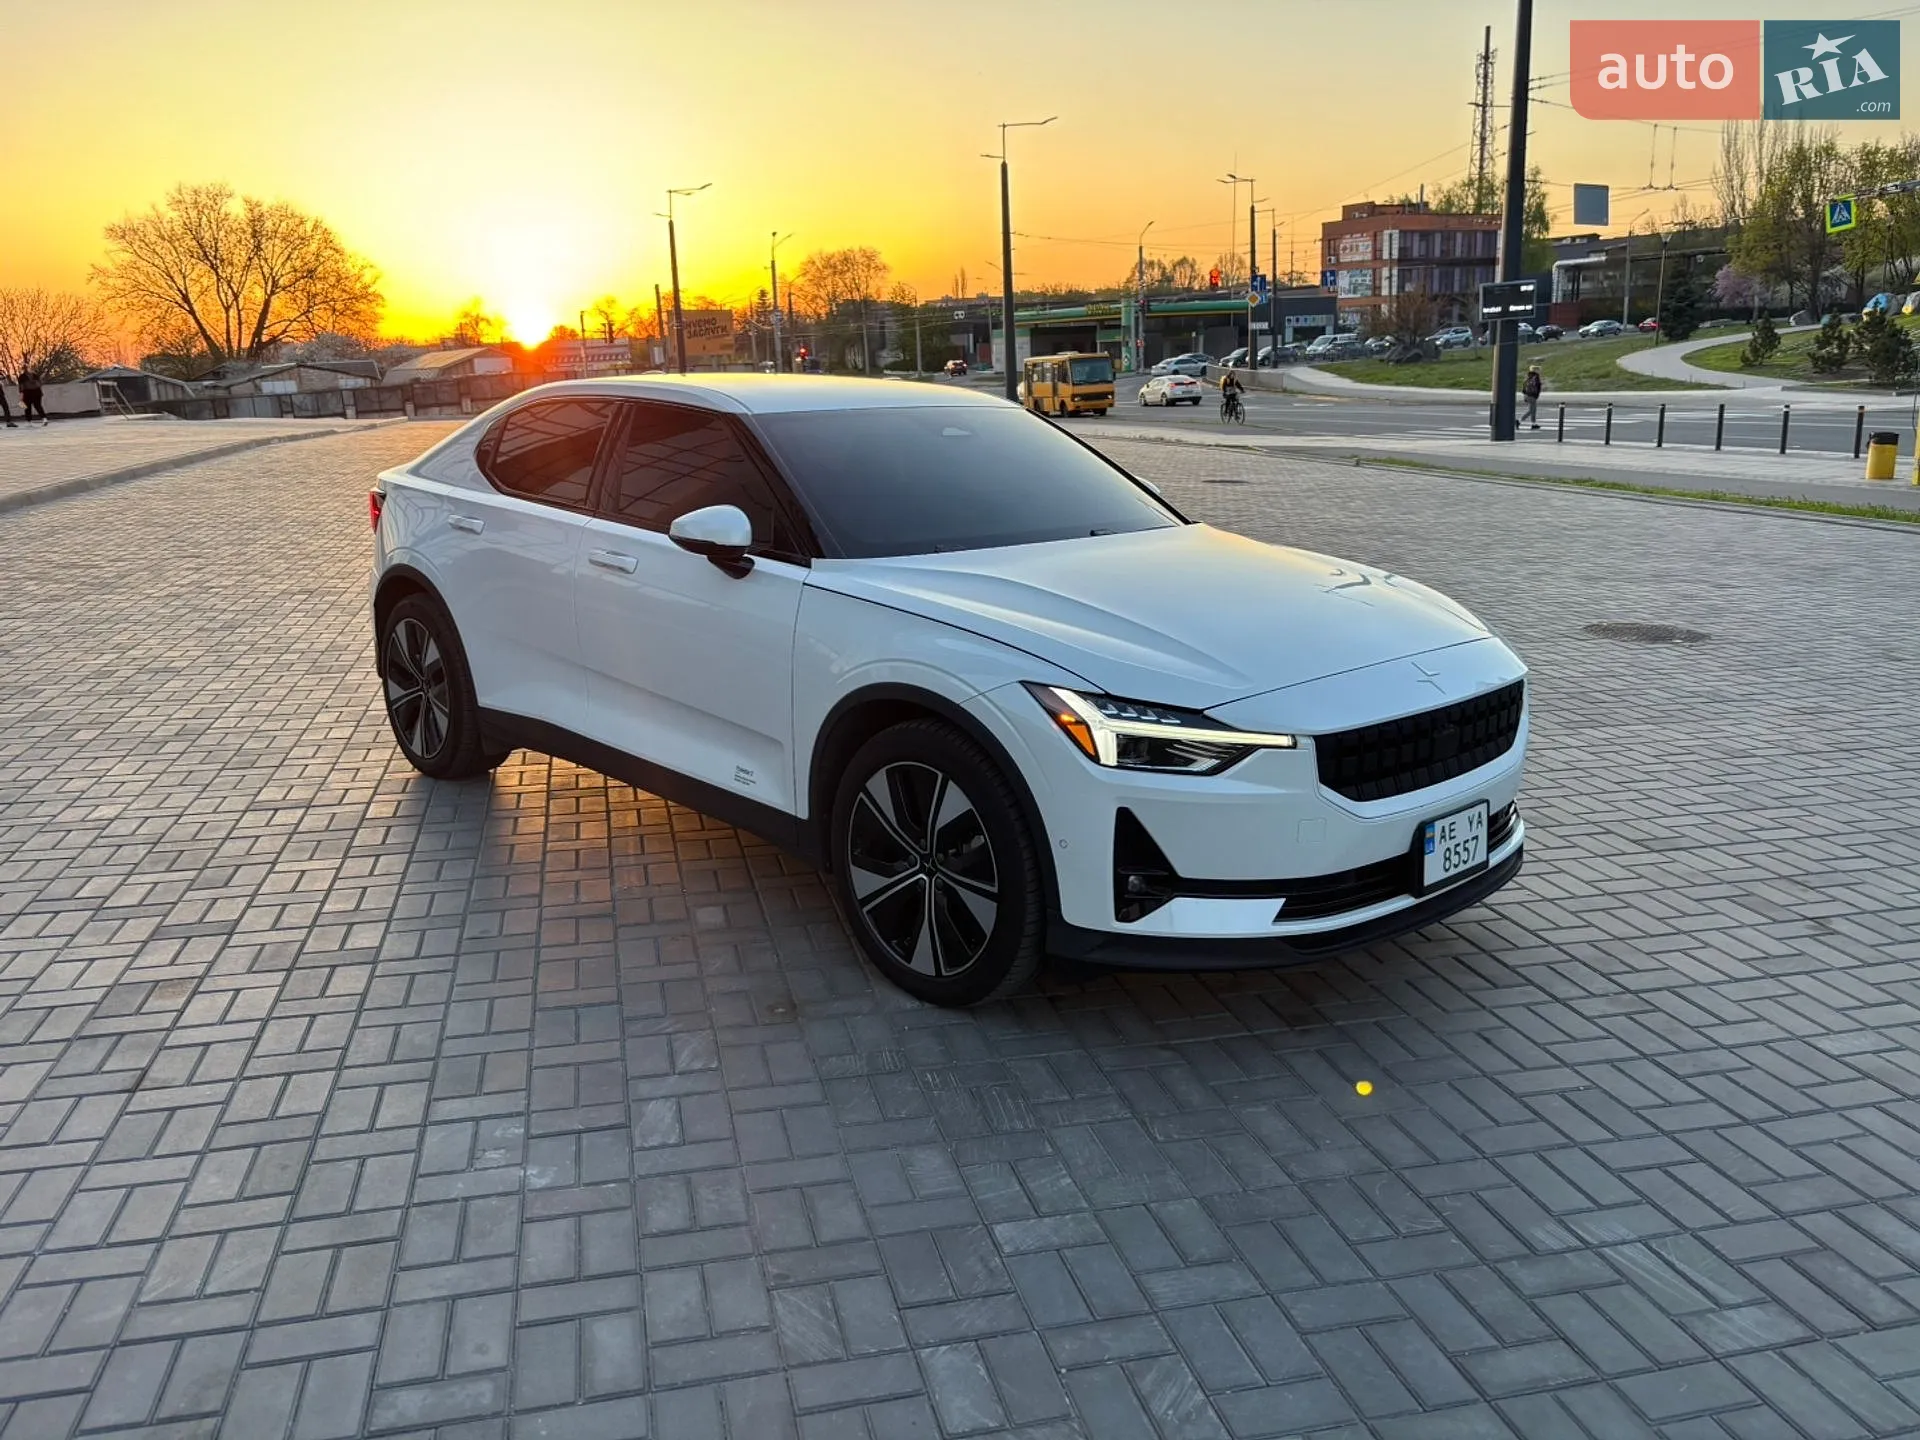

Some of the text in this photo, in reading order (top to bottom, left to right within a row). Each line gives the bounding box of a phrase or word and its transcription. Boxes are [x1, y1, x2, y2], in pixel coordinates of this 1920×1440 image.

[1439, 811, 1483, 844] AE YA
[1443, 835, 1479, 872] 8557
